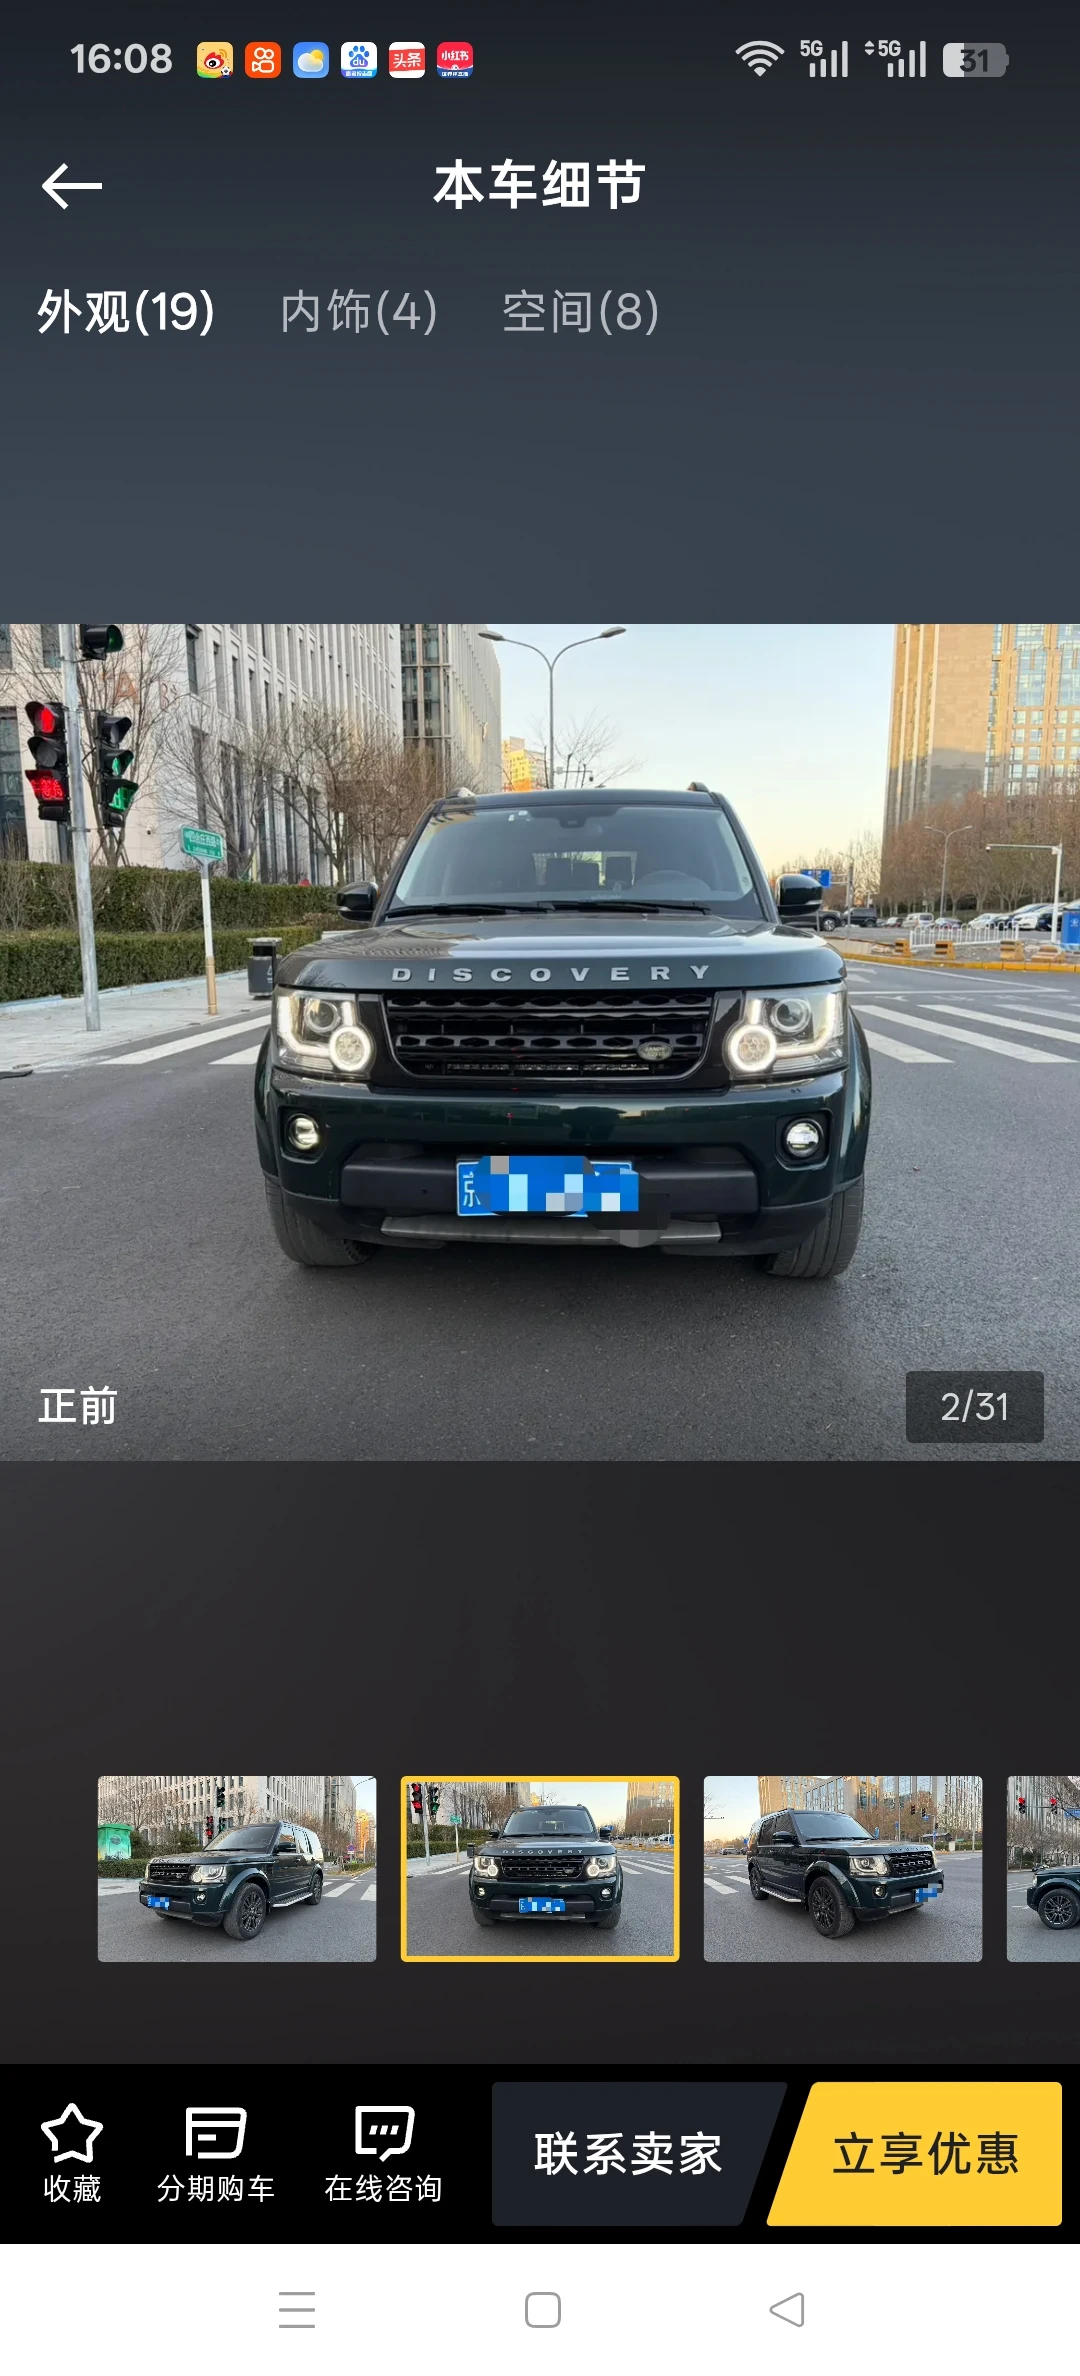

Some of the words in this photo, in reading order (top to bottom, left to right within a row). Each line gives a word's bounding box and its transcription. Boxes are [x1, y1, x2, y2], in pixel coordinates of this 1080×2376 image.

[70, 43, 173, 74] 16:08
[352, 57, 365, 66] du
[393, 52, 421, 69] 头条
[441, 50, 469, 61] 小红书
[800, 40, 824, 57] 5G
[878, 40, 902, 57] 5G
[959, 49, 988, 73] 31
[433, 159, 646, 210] 本车细节
[37, 288, 214, 337] 外观(19)
[282, 288, 437, 336] 内饰(4)
[503, 288, 658, 336] 空间(8)
[391, 965, 710, 983] DISCOVERY
[534, 2130, 723, 2176] 联系卖家
[832, 2130, 1019, 2176] 立享优惠
[43, 2174, 102, 2204] 收藏
[157, 2173, 275, 2203] 分期购车
[324, 2173, 442, 2203] 在线咨询
